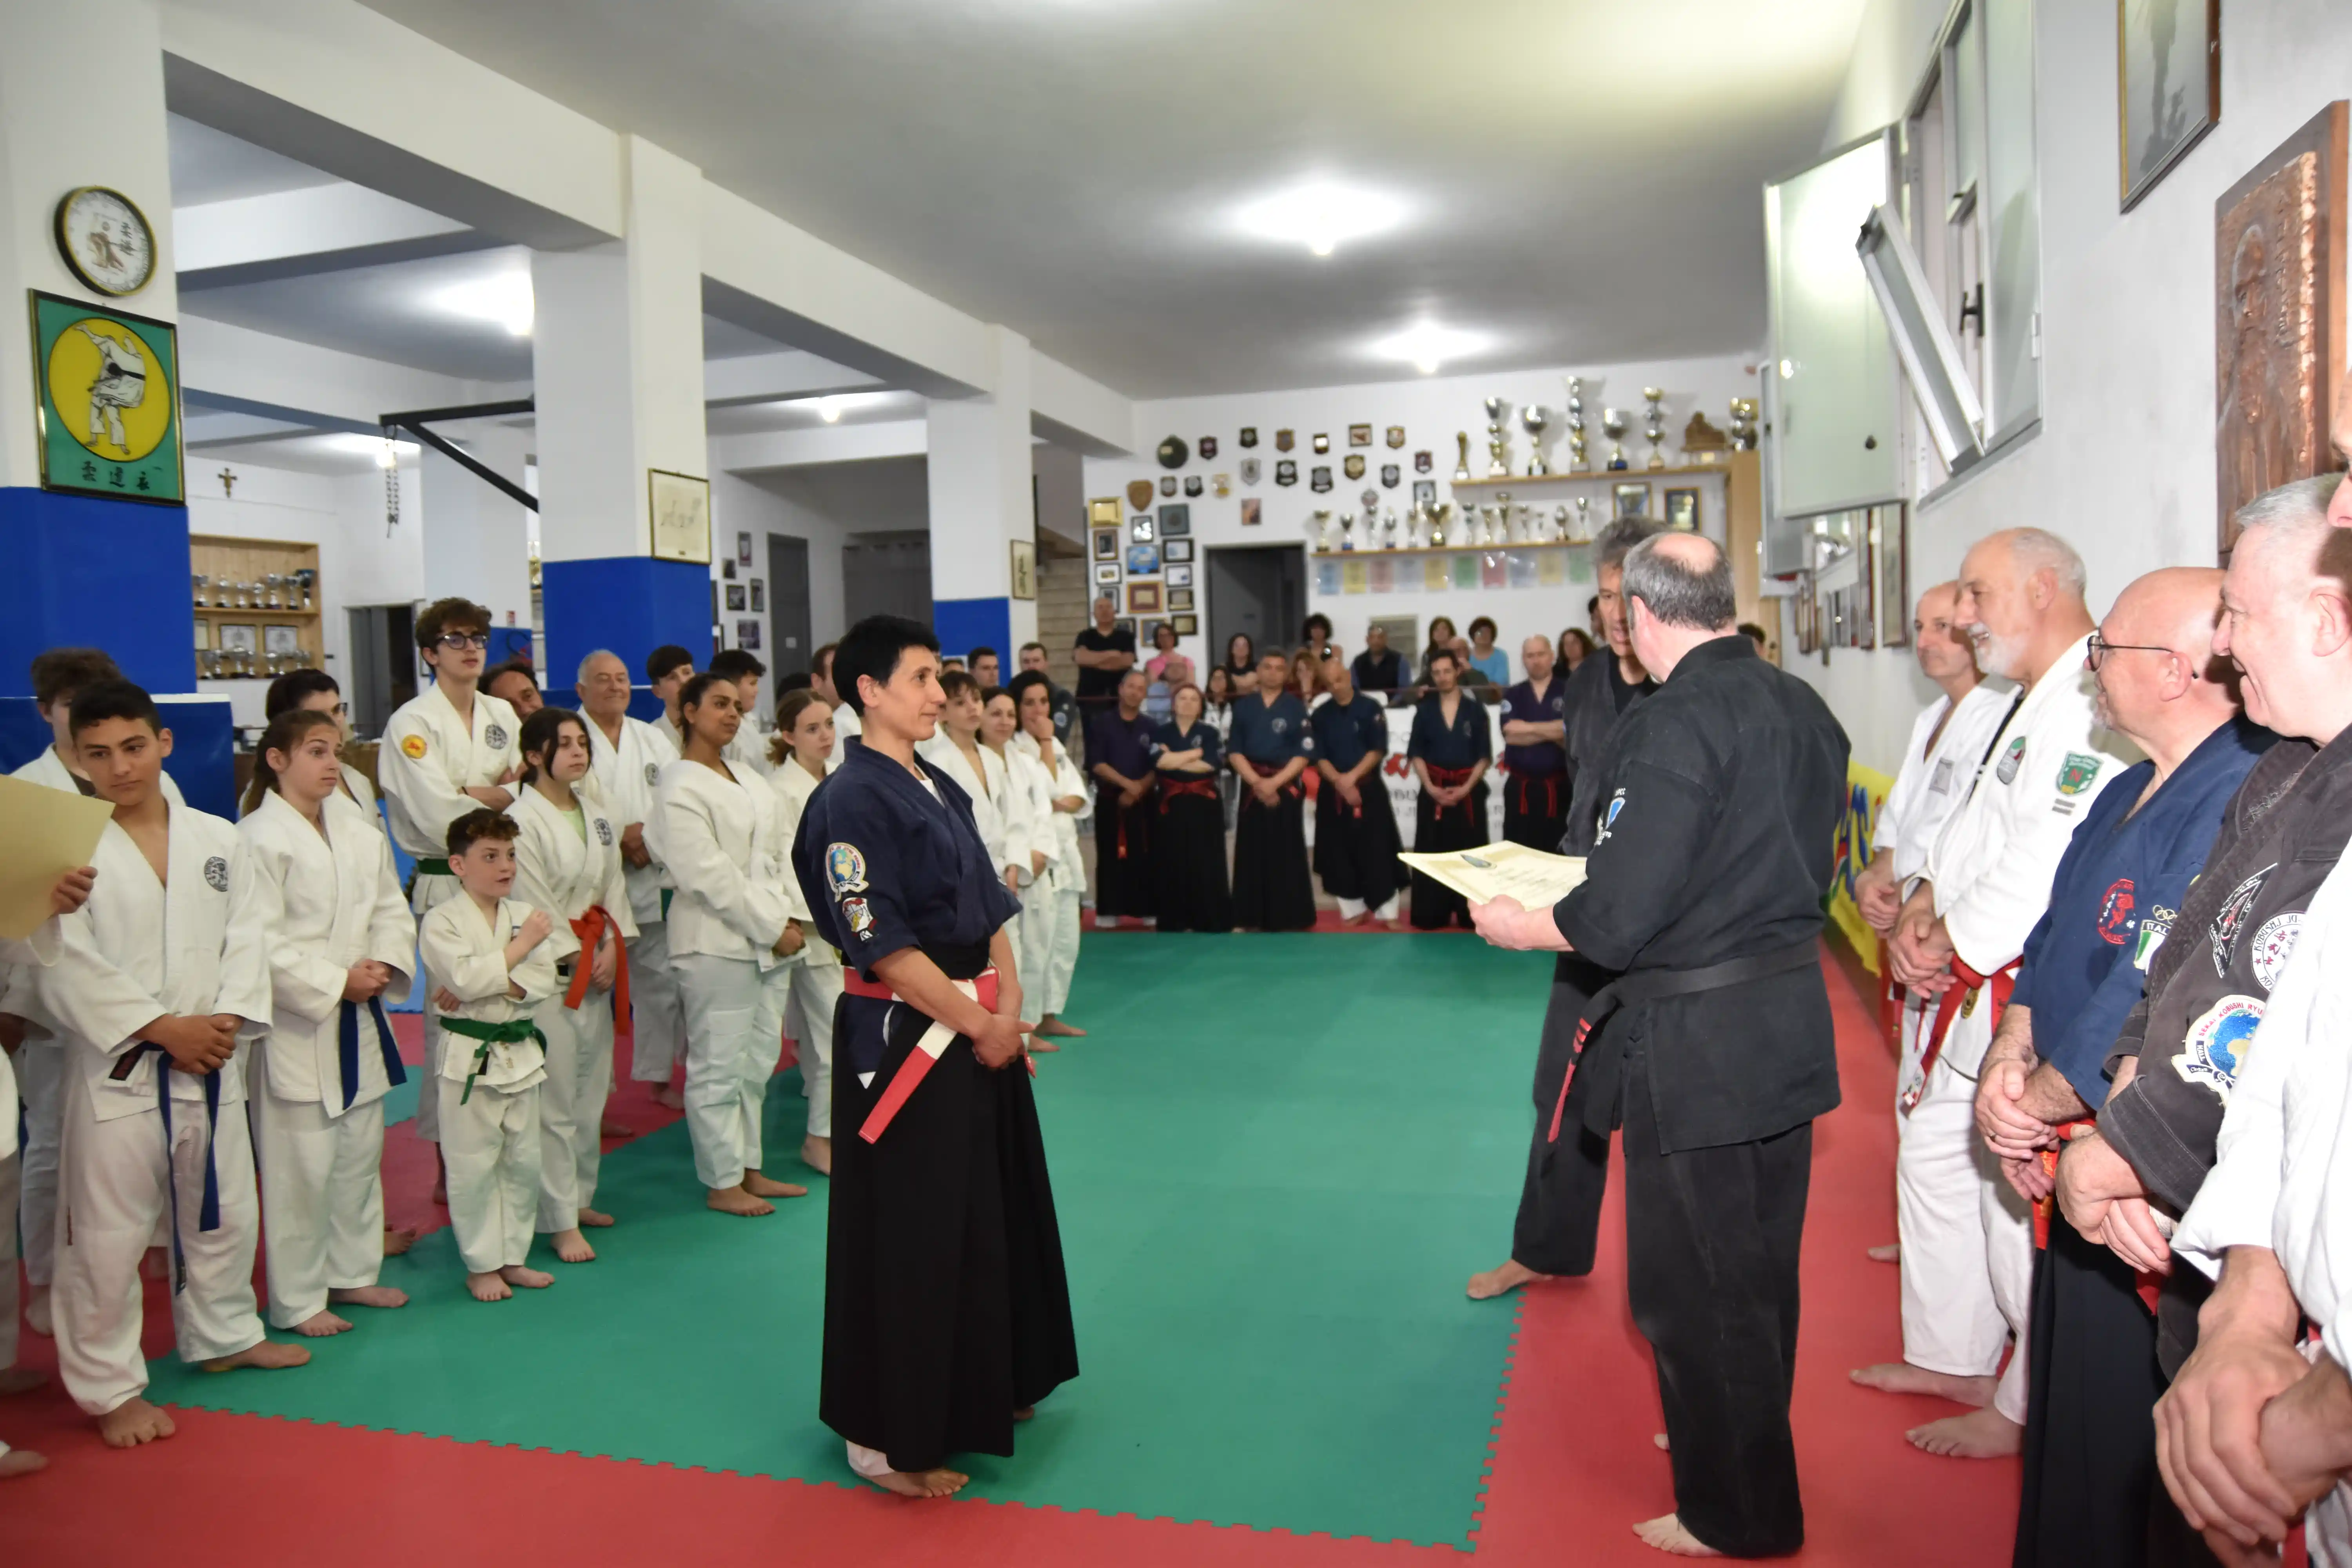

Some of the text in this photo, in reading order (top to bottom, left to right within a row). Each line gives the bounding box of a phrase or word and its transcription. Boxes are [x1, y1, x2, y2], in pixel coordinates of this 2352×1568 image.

[2146, 922, 2168, 935] ITAL
[2198, 1002, 2263, 1036] SEKAI KOBUSHI RYU
[2196, 1044, 2205, 1062] HALL
